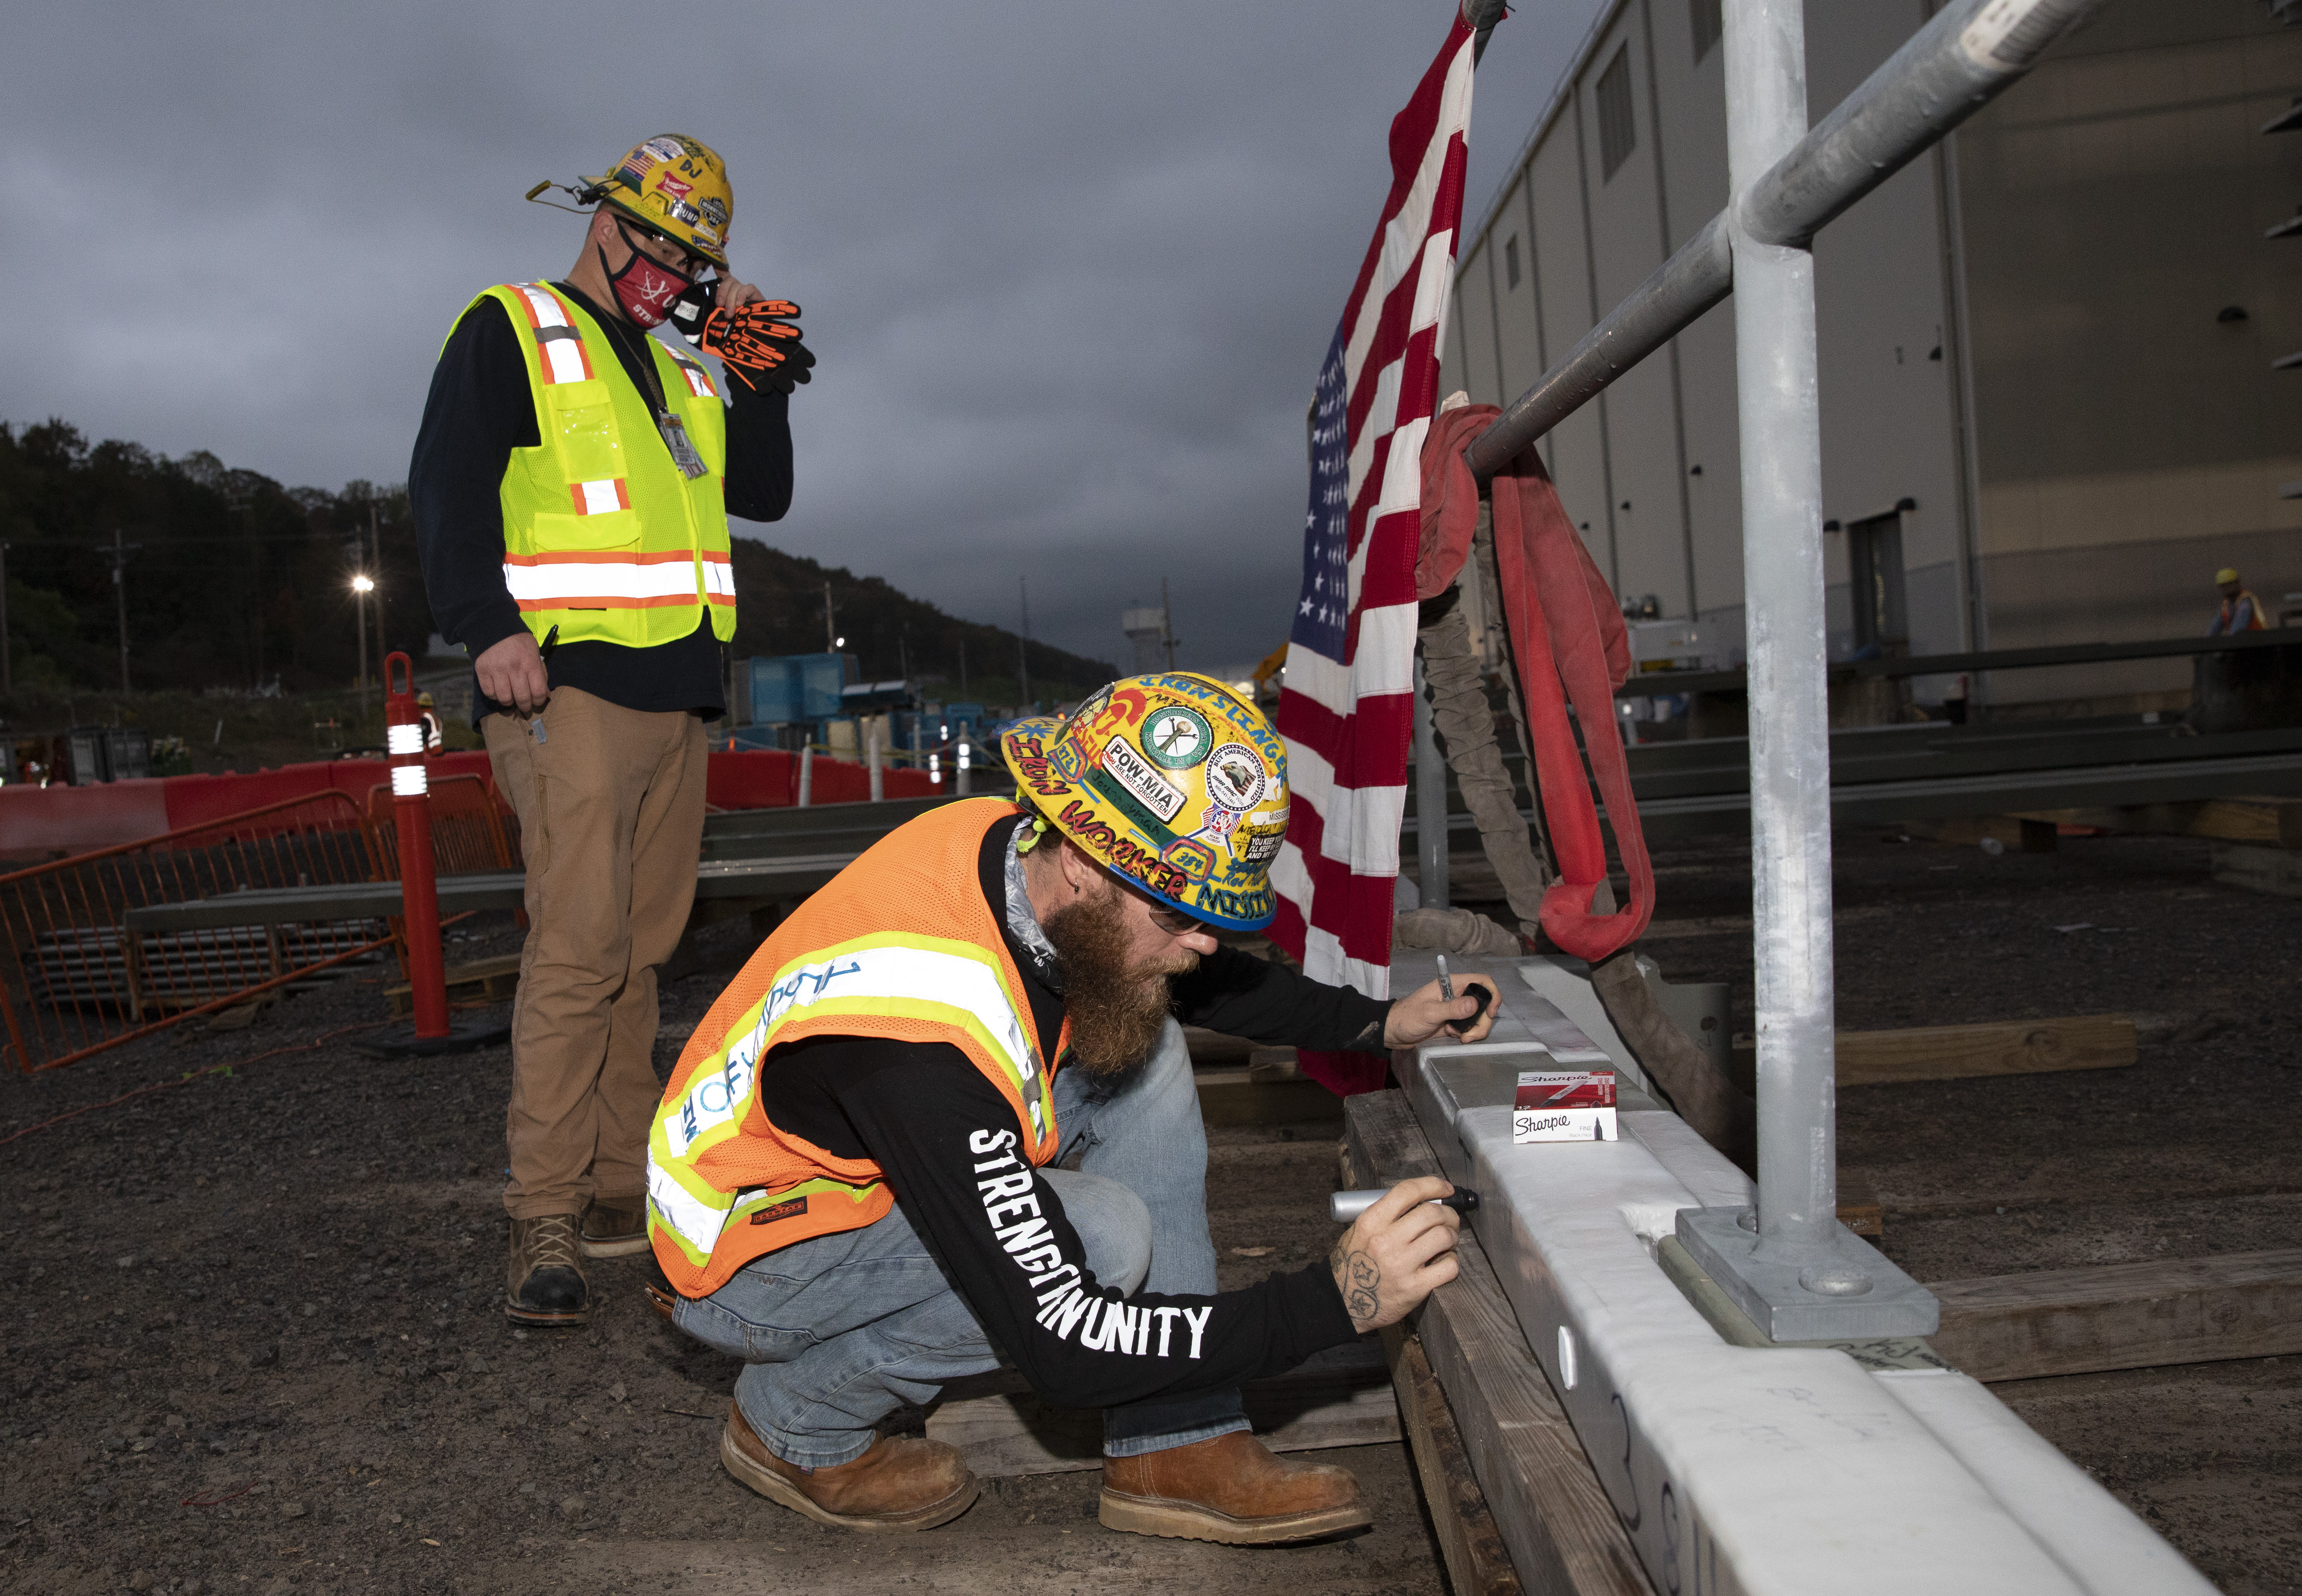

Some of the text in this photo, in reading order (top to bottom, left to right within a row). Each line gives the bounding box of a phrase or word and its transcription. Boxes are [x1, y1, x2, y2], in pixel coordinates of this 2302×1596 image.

[679, 159, 702, 178] DJ
[673, 203, 698, 222] TRUMP
[1150, 710, 1207, 758] IRONWORKERS LOCAL 384
[1007, 735, 1072, 796] IRON
[1110, 743, 1173, 808] POW-MIA
[1214, 749, 1262, 801] BUY AMERICAN CERTIFIED
[1115, 763, 1126, 775] ARE
[1125, 773, 1137, 785] NOT
[1136, 783, 1168, 814] FORGOTTEN
[1212, 775, 1245, 806] MAR-MAC Wire
[1214, 784, 1235, 805] 800-541-2461
[1205, 836, 1220, 844] FLORIDA
[1263, 837, 1275, 845] KEEP
[1058, 800, 1188, 903] WORKER
[1176, 852, 1204, 872] 384
[1517, 1075, 1592, 1084] Sharpie
[1515, 1115, 1570, 1136] Sharpie
[756, 1205, 800, 1221] RADWEAR
